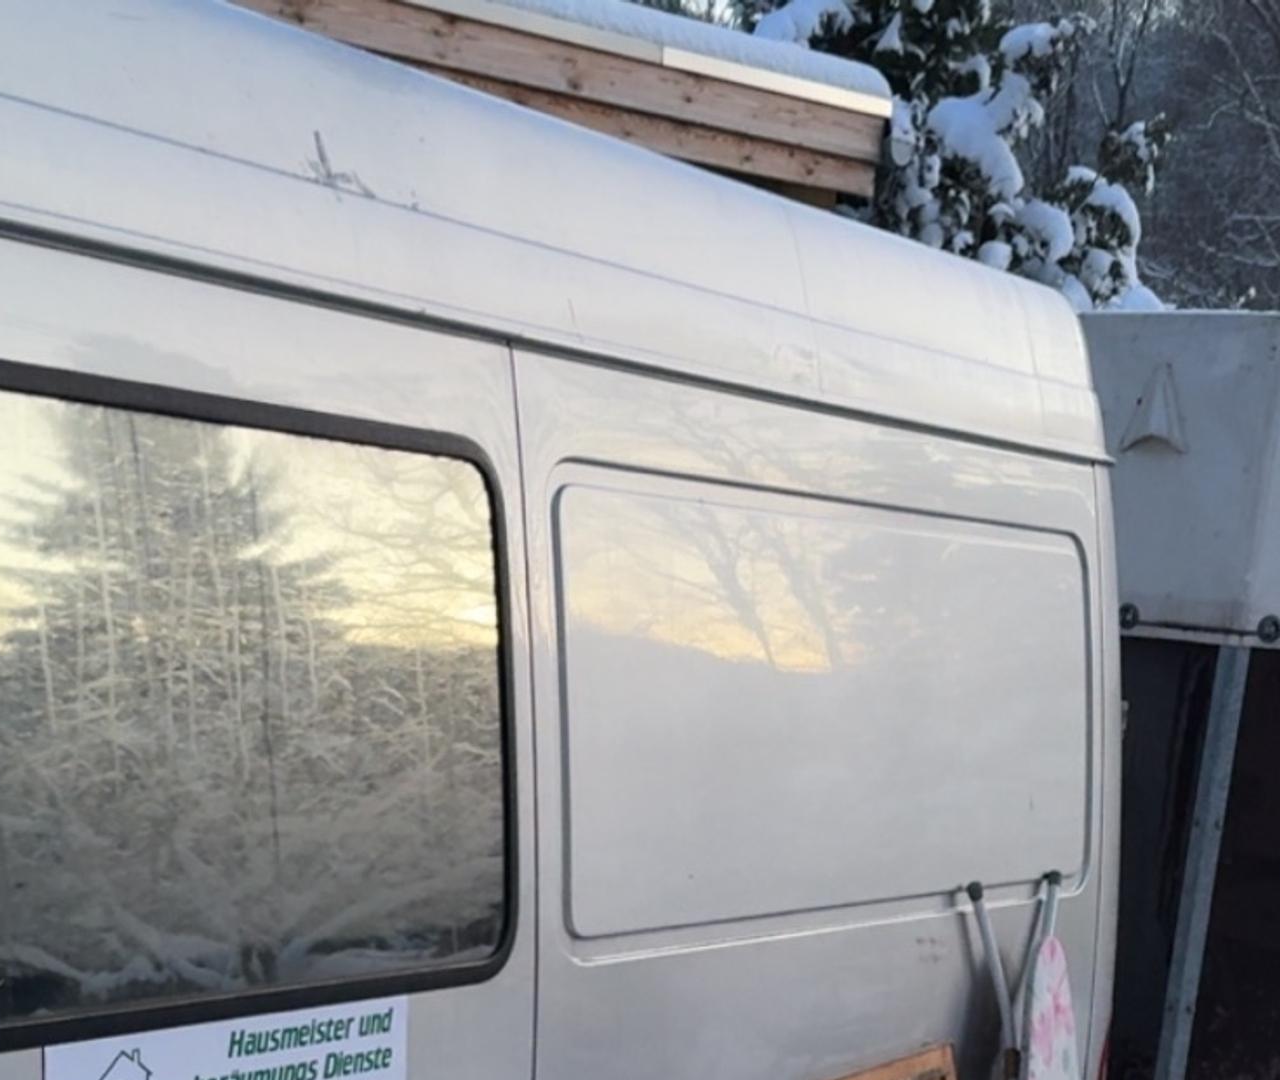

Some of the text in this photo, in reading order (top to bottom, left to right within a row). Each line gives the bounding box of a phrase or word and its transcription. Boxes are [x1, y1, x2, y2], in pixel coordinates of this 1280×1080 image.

[228, 1007, 394, 1058] Hausmeister und
[323, 1046, 392, 1079] Dienste
